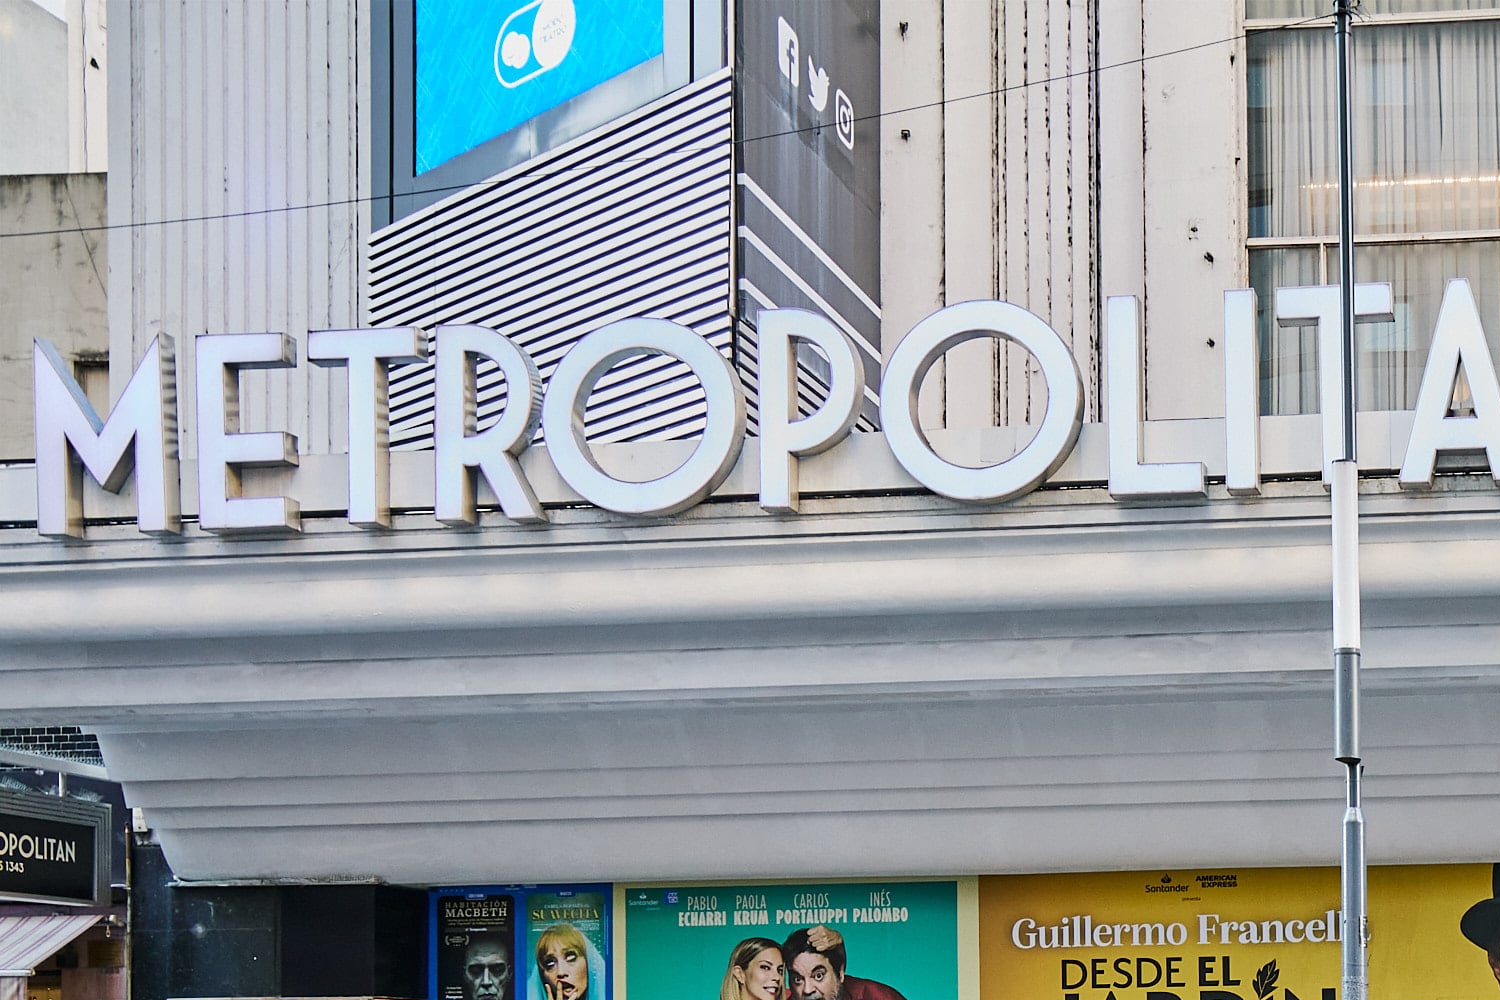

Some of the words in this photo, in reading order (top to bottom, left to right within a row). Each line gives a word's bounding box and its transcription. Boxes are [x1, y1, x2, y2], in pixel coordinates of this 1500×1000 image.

[1145, 884, 1190, 893] Santander
[687, 896, 717, 911] PABLO
[735, 895, 767, 909] PAOLA
[793, 892, 830, 909] CARLOS
[869, 889, 892, 907] INÉS
[445, 908, 507, 918] MACBETH
[532, 908, 599, 920] SUAVECITA
[678, 911, 727, 927] ECHARRI
[733, 910, 769, 925] KRUM
[776, 909, 848, 925] PORTALUPPI
[853, 907, 908, 923] PALOMBO
[1011, 916, 1188, 949] Guillermo
[1197, 909, 1371, 944] Francell
[1061, 957, 1186, 990] DESDE
[1199, 956, 1241, 987] EL
